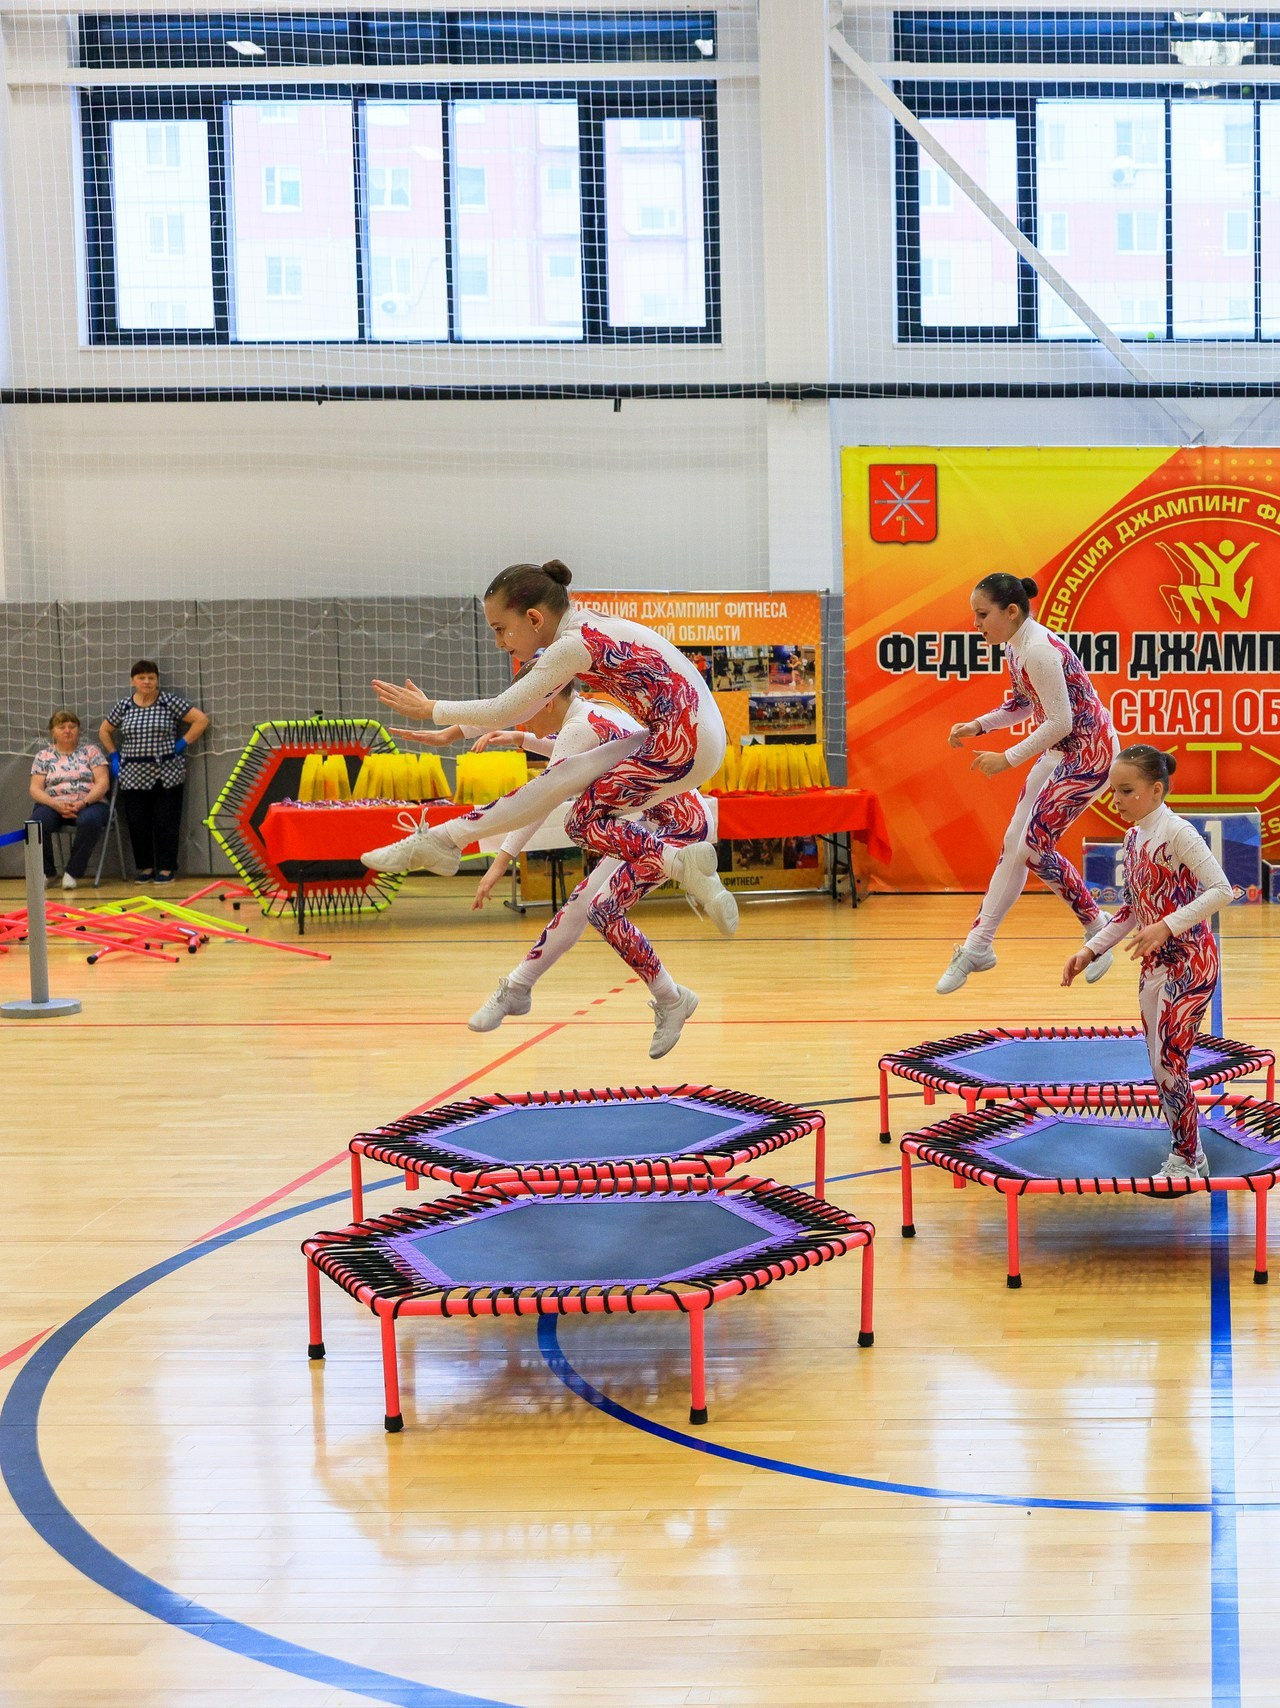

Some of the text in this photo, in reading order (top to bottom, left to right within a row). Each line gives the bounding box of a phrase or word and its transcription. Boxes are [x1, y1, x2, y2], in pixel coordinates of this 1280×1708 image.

[1046, 535, 1114, 632] ДЕРАЦИЯ
[1115, 495, 1250, 544] ДЖАМПИНГ
[641, 602, 722, 620] ДЖАМПИНГ
[724, 602, 788, 619] ФИТНЕСА
[678, 625, 741, 641] ОБЛАСТИ
